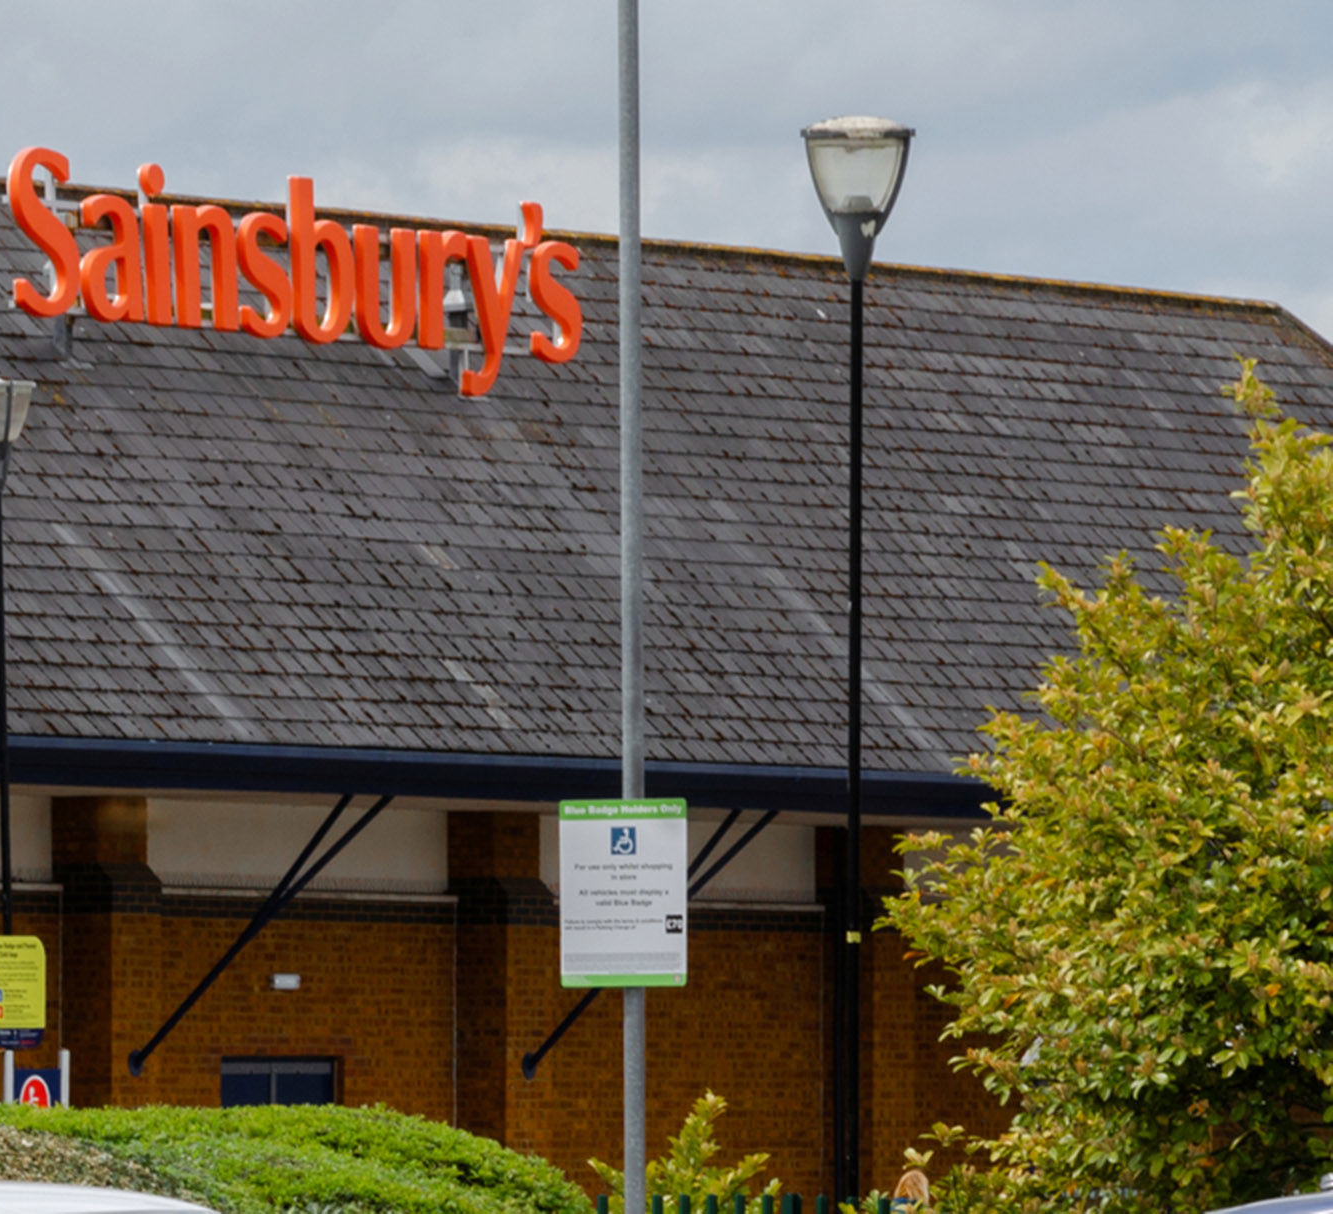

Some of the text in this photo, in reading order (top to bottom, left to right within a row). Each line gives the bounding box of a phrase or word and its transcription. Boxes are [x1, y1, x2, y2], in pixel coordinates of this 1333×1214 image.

[6, 146, 583, 397] Sainsbury's
[564, 802, 682, 817] Blue Badge Holders Only
